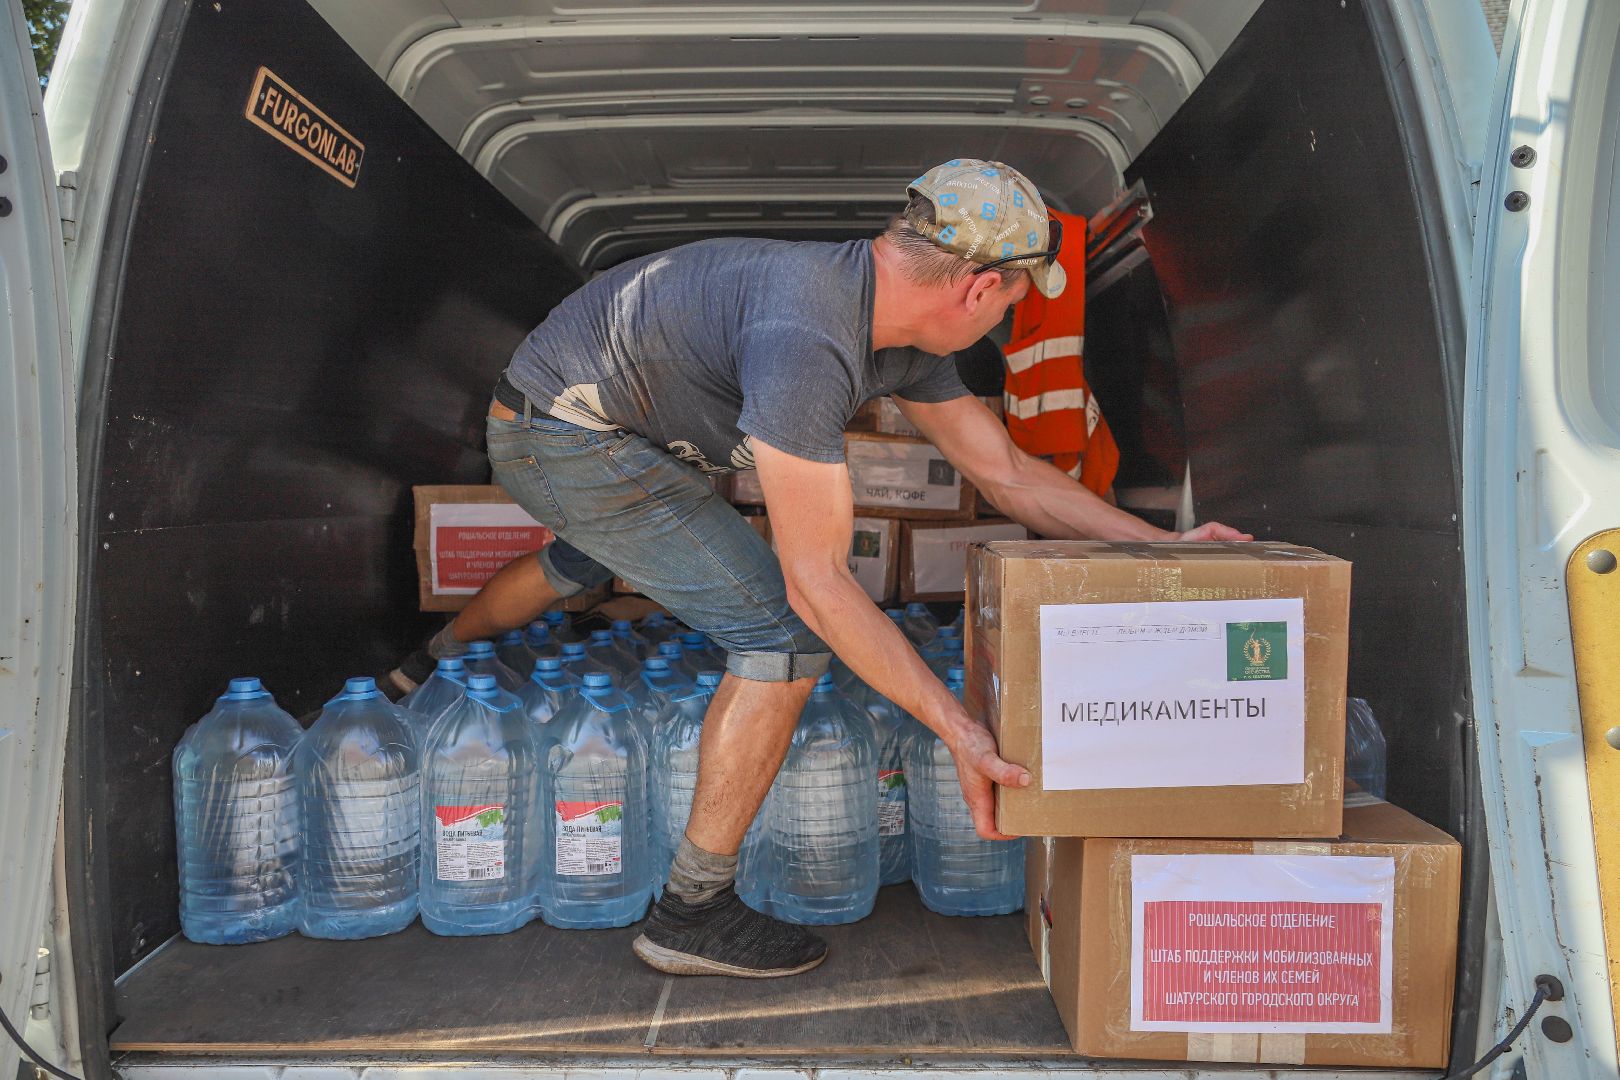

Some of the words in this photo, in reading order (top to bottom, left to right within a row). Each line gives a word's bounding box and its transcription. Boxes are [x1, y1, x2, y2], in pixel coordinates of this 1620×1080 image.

[261, 86, 357, 175] FURGONLAB
[867, 487, 892, 500] ЧАЙ,
[896, 490, 926, 501] КОФЕ
[498, 532, 531, 540] ОТДЕЛЕНИЕ
[1061, 697, 1266, 726] МЕДИКАМЕНТЫ
[1189, 913, 1267, 928] РОШАЛЬСКОЕ
[1270, 913, 1336, 929] ОТДЕЛЕНИЕ
[1151, 949, 1181, 963] ШТАБ
[1185, 949, 1259, 965] ПОДДЕРЖКИ
[1263, 950, 1373, 966] МОБИЛИЗОВАННЫХ
[1203, 970, 1211, 983] И
[1214, 970, 1260, 984] ЧЛЕНОВ
[1263, 970, 1278, 984] ИХ
[1281, 969, 1320, 984] СЕМЕЙ
[1165, 992, 1238, 1006] ШАТУРСКОГО
[1241, 992, 1314, 1008] ГОРОДСКОГО
[1317, 993, 1359, 1007] ОКРУГА
